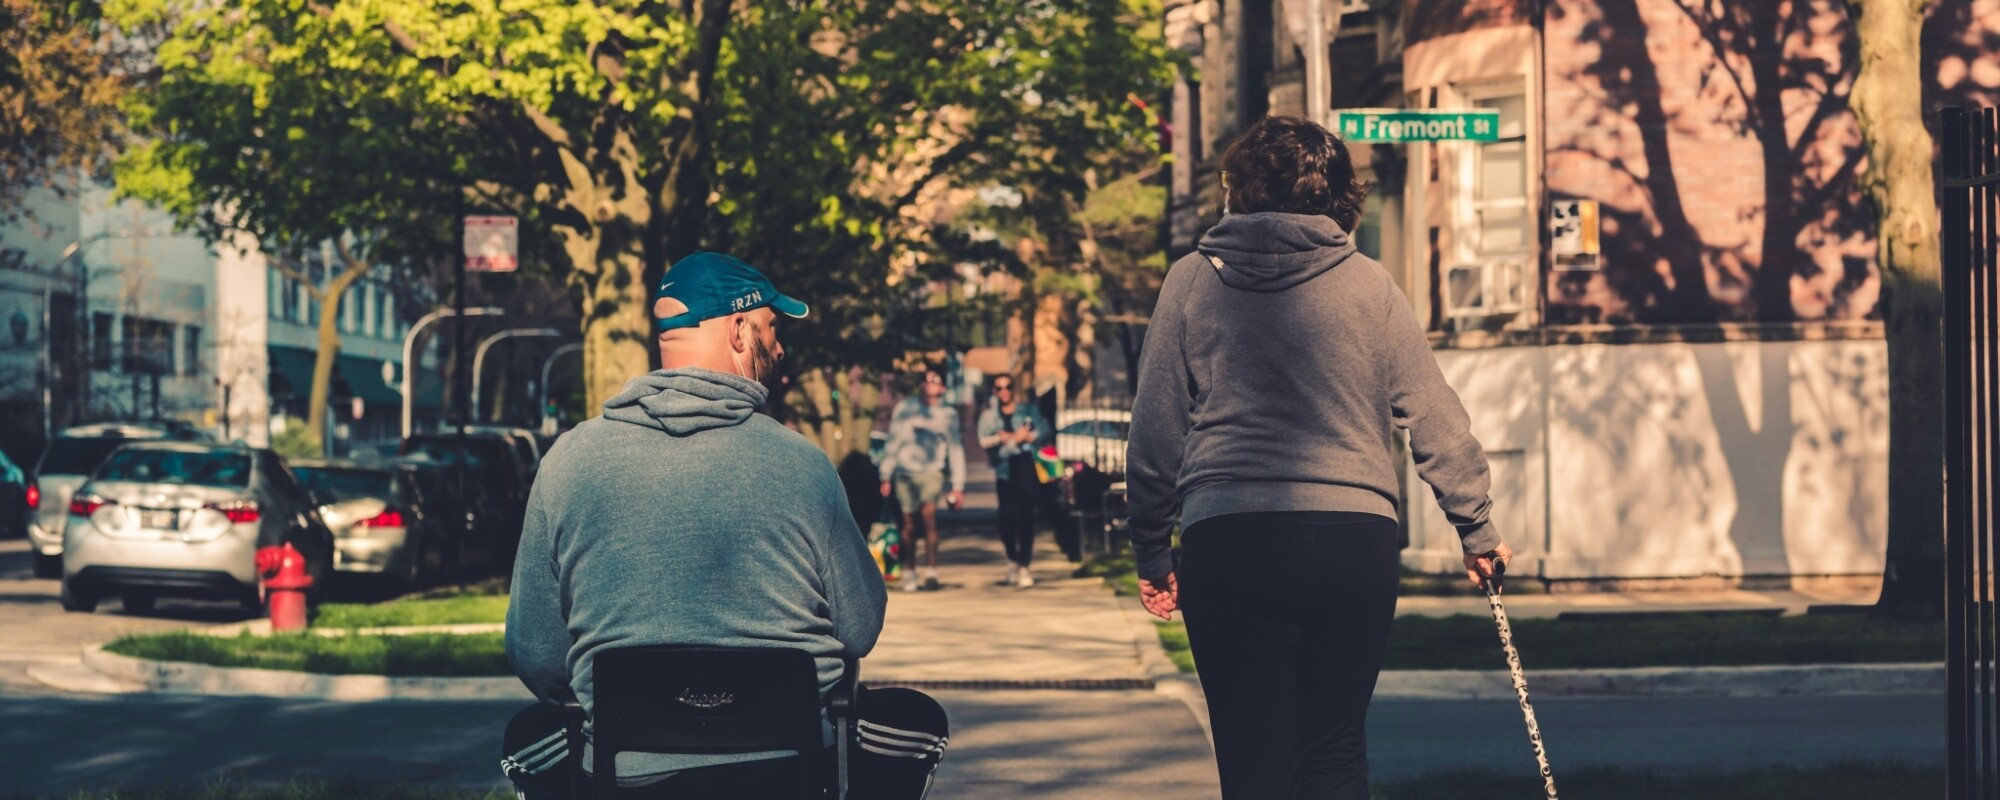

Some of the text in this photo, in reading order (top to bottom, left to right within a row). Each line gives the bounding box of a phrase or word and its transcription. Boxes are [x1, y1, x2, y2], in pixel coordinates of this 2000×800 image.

[1345, 115, 1490, 139] N Fremont St
